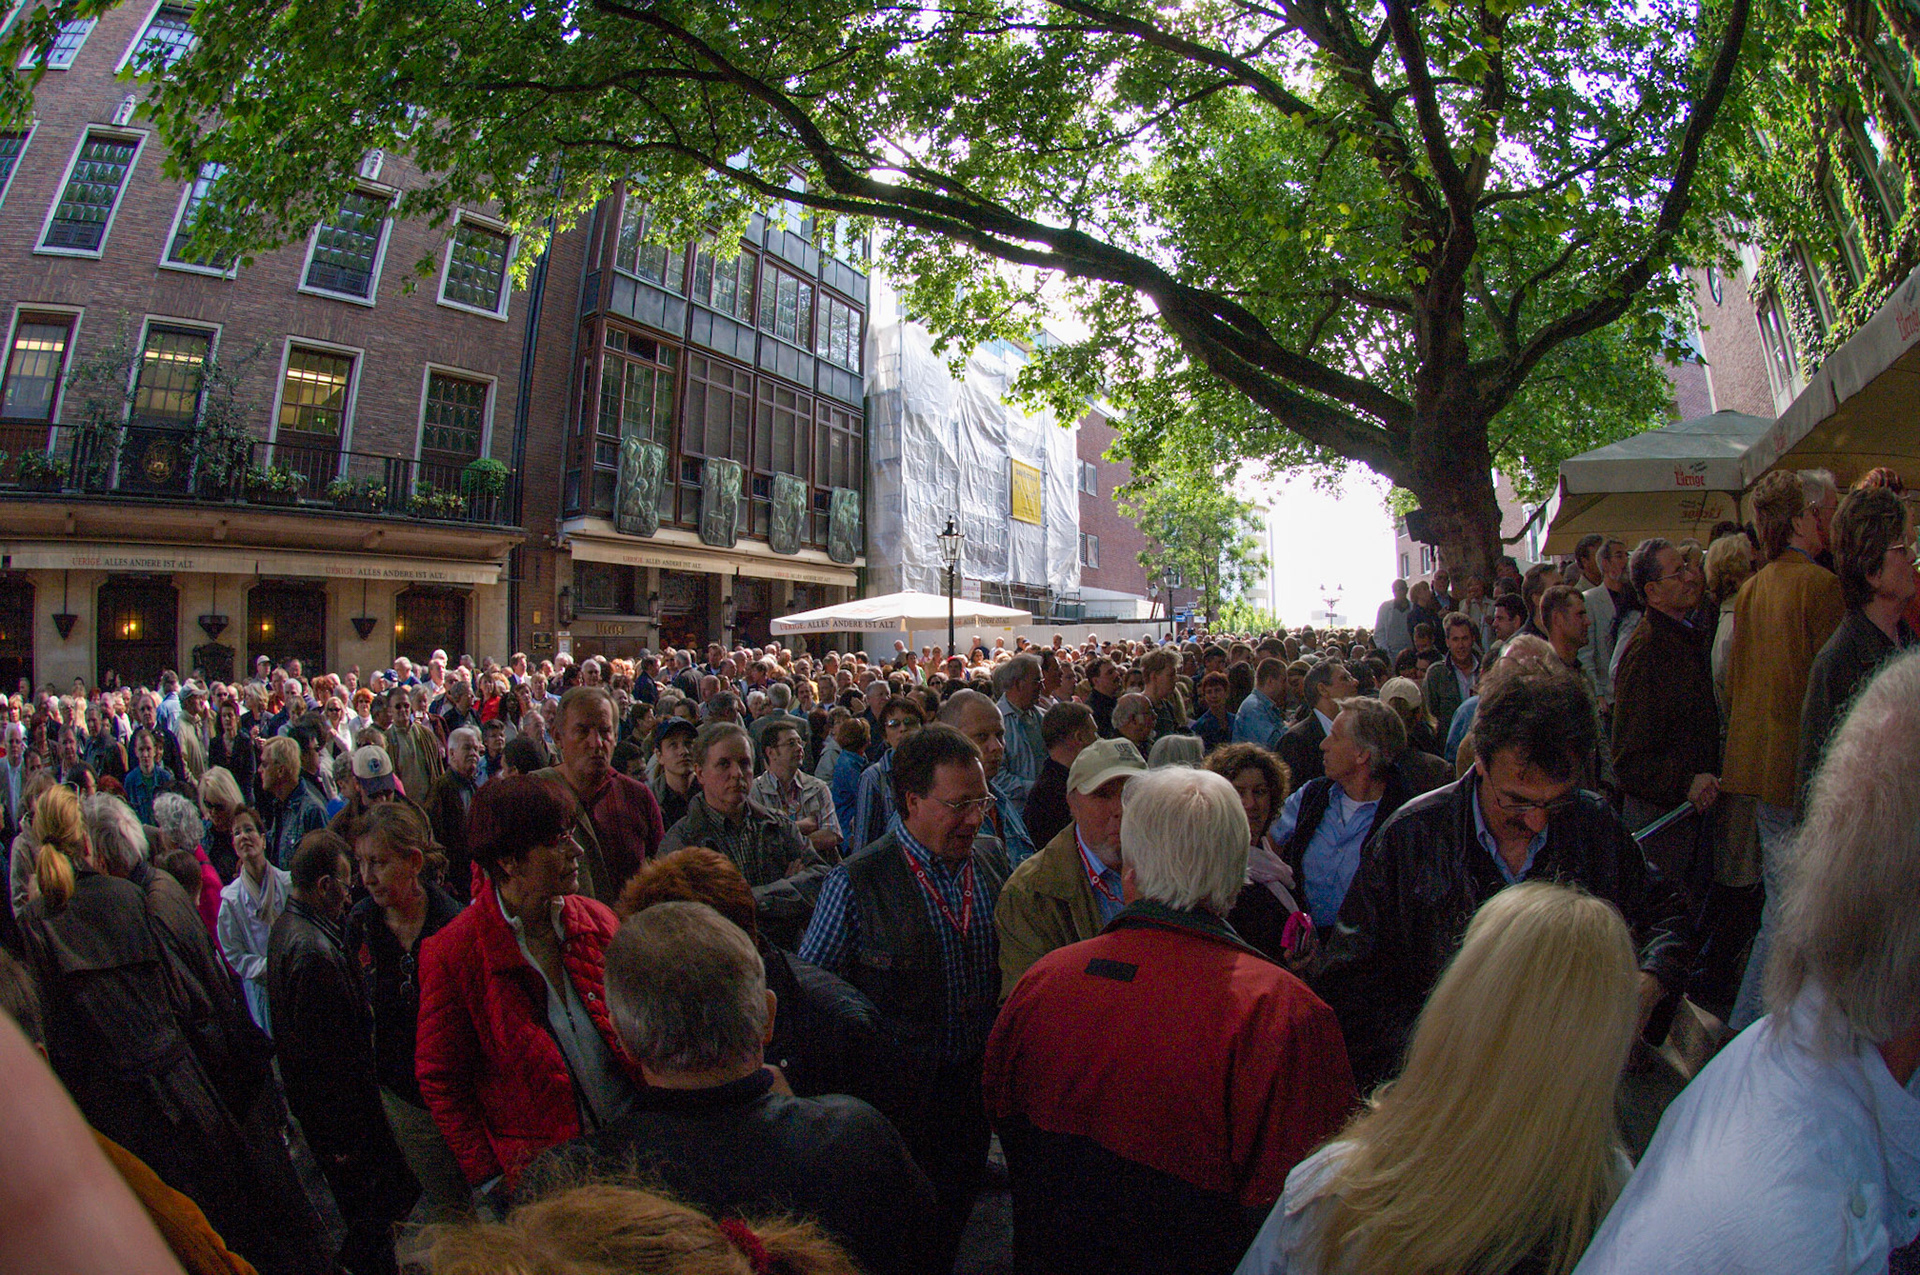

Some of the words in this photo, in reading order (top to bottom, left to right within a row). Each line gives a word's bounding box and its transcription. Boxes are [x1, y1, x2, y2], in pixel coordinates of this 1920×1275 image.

[104, 558, 128, 567] ALLES
[129, 559, 161, 568] ANDERE
[163, 560, 176, 569] IST
[358, 568, 381, 576] ALLES
[382, 569, 413, 578] ANDERE
[415, 570, 427, 579] IST
[807, 621, 830, 629] ALLES
[832, 620, 863, 629] ANDERE
[865, 620, 878, 629] IST
[878, 620, 896, 629] ALT.
